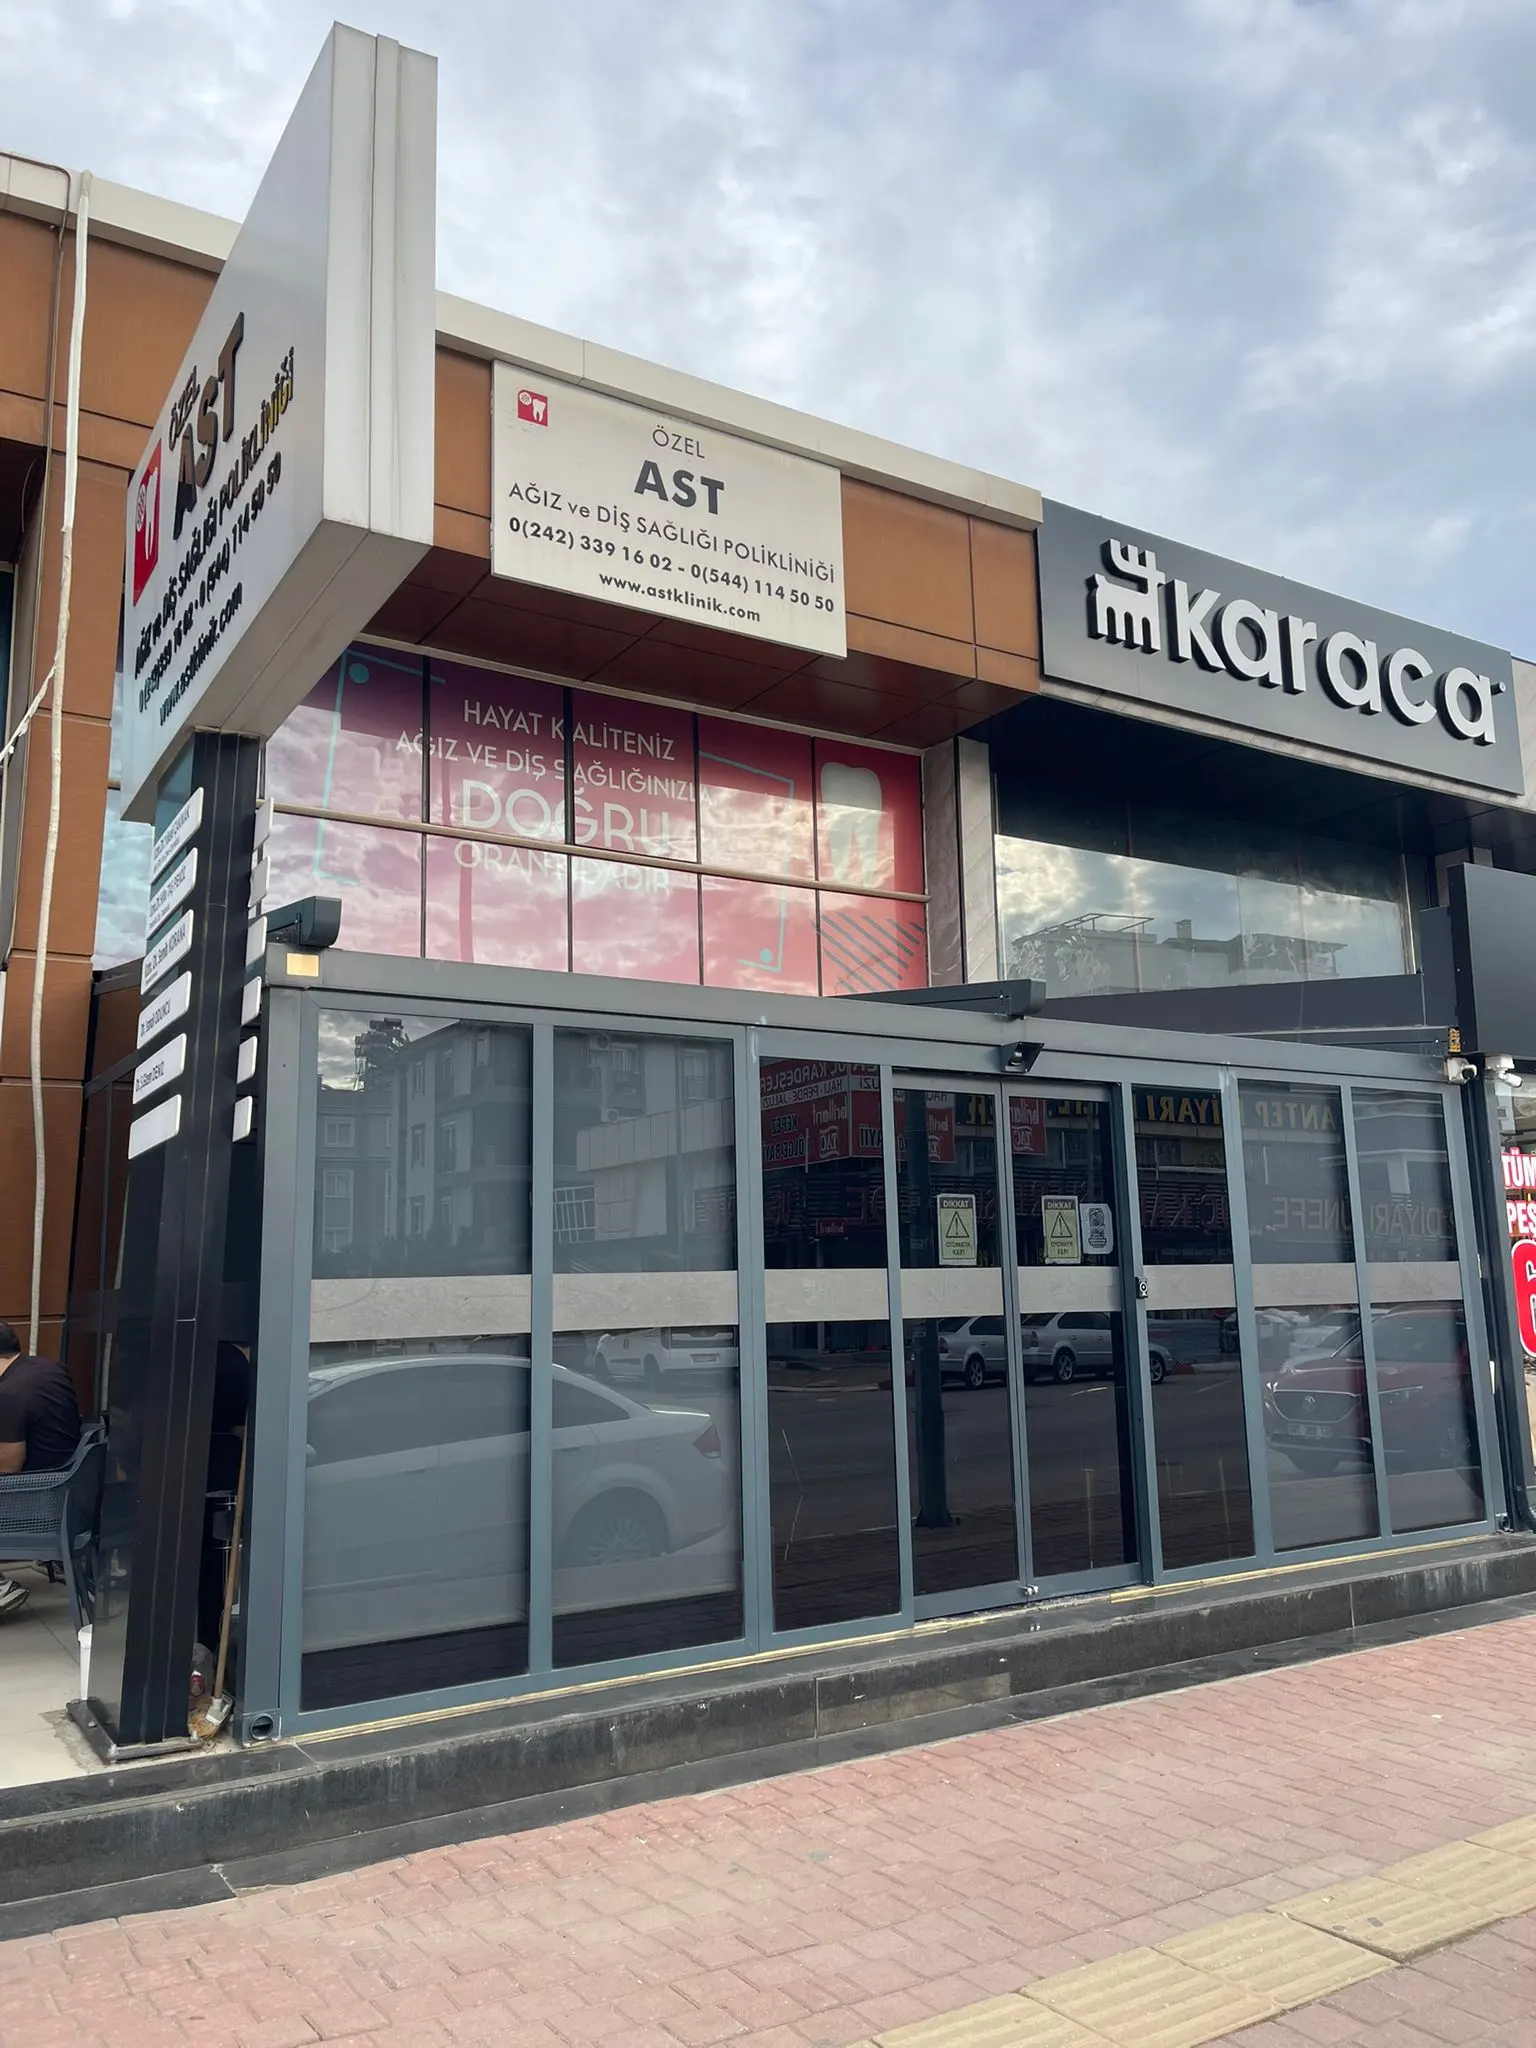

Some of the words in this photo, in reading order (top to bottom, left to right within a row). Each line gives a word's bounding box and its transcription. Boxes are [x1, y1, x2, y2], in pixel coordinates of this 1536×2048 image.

[169, 365, 200, 451] ÖZEL
[173, 312, 244, 540] AST
[219, 346, 294, 526] POLİKLİNİĞİ
[652, 424, 705, 459] ÖZEL
[251, 479, 265, 521] 50
[267, 451, 281, 495] 50
[634, 460, 725, 515] AST
[509, 482, 562, 511] AĞIZ
[568, 502, 590, 518] ve
[597, 505, 630, 533] DİŞ
[637, 517, 717, 552] SAĞLIĞI
[724, 539, 834, 583] POLİKLİNİĞİ
[509, 517, 574, 550] 0(242)
[580, 535, 616, 556] 339
[623, 546, 644, 565] 16
[650, 554, 672, 572] 02
[691, 564, 748, 594] 0(544)
[754, 580, 785, 599] 114
[790, 589, 809, 606] 50
[815, 595, 834, 612] 50
[599, 571, 760, 622] www.astklinik.com
[1168, 577, 1496, 746] karaca
[463, 700, 543, 736] HAYAT
[551, 717, 675, 761] KALİTENİZ
[467, 742, 497, 768] VE
[506, 748, 546, 781] DİŞ
[462, 779, 671, 857] DOĞRU
